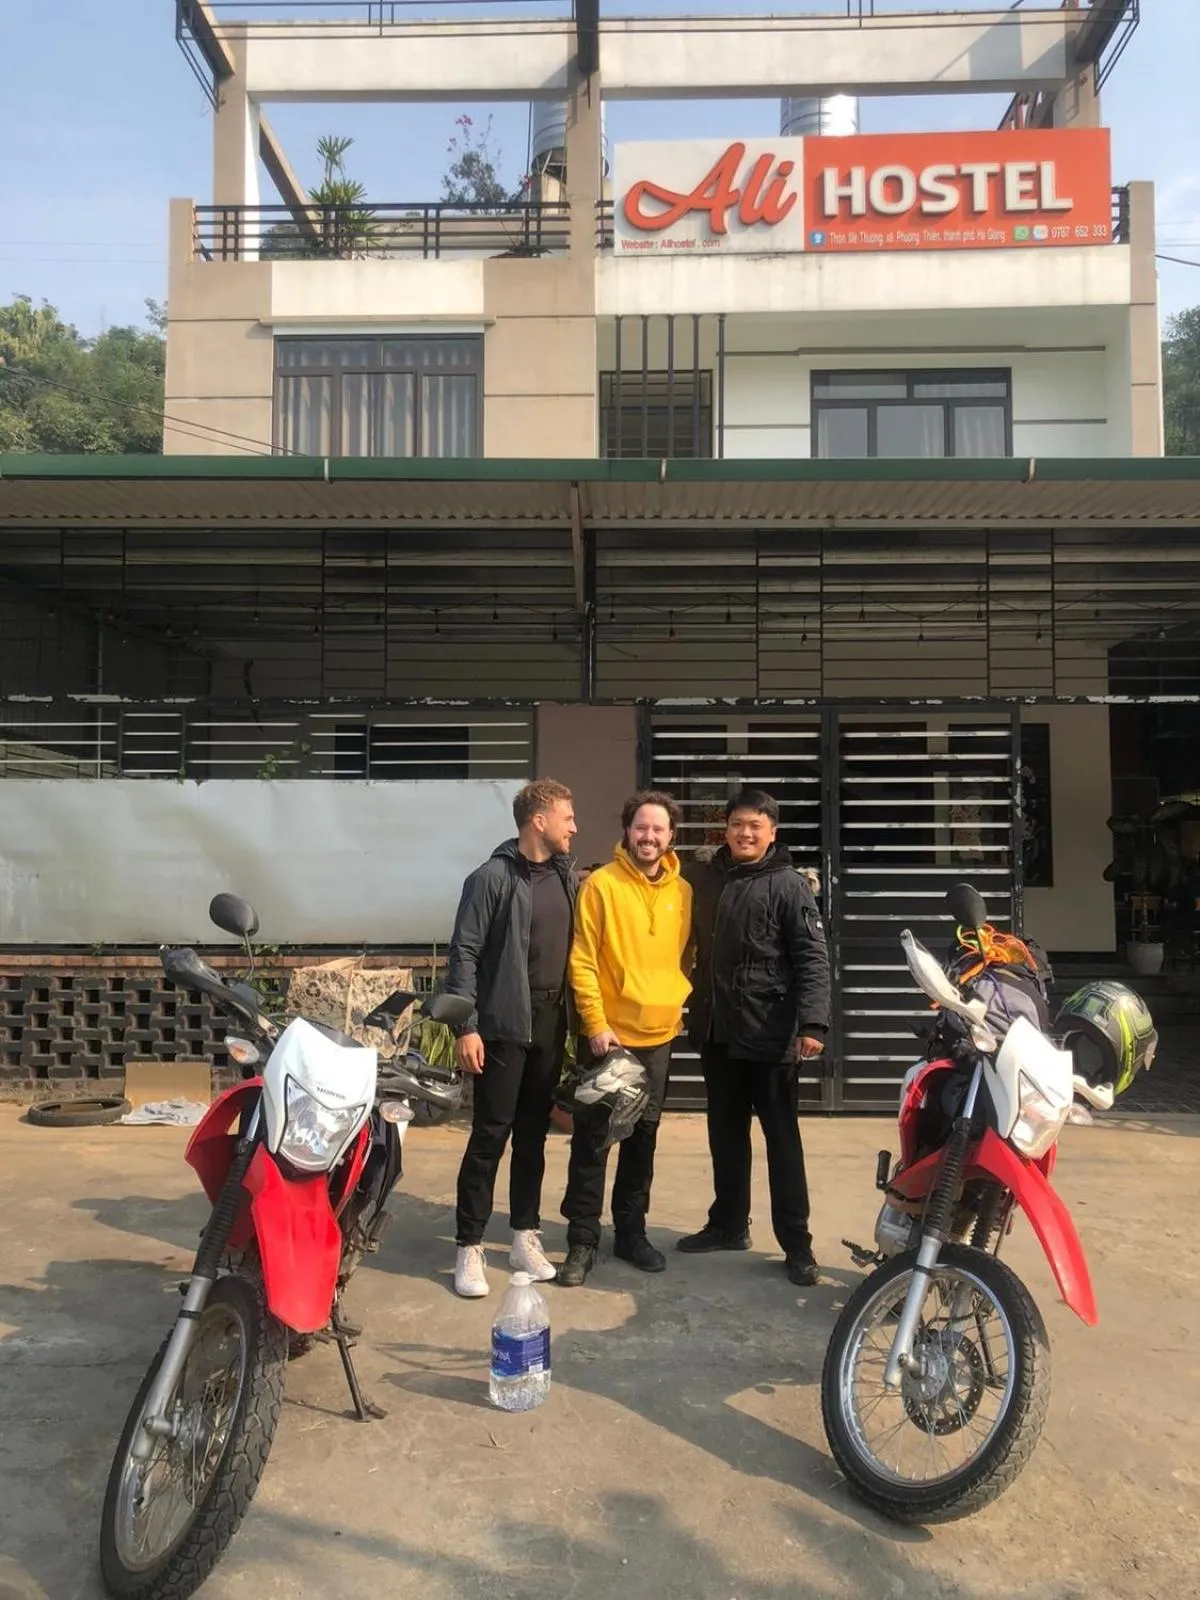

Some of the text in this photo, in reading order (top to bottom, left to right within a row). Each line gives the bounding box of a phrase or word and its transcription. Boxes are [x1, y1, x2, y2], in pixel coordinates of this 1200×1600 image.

[623, 142, 798, 235] Ali
[823, 161, 1074, 216] HOSTEL
[316, 1086, 346, 1100] HONDA
